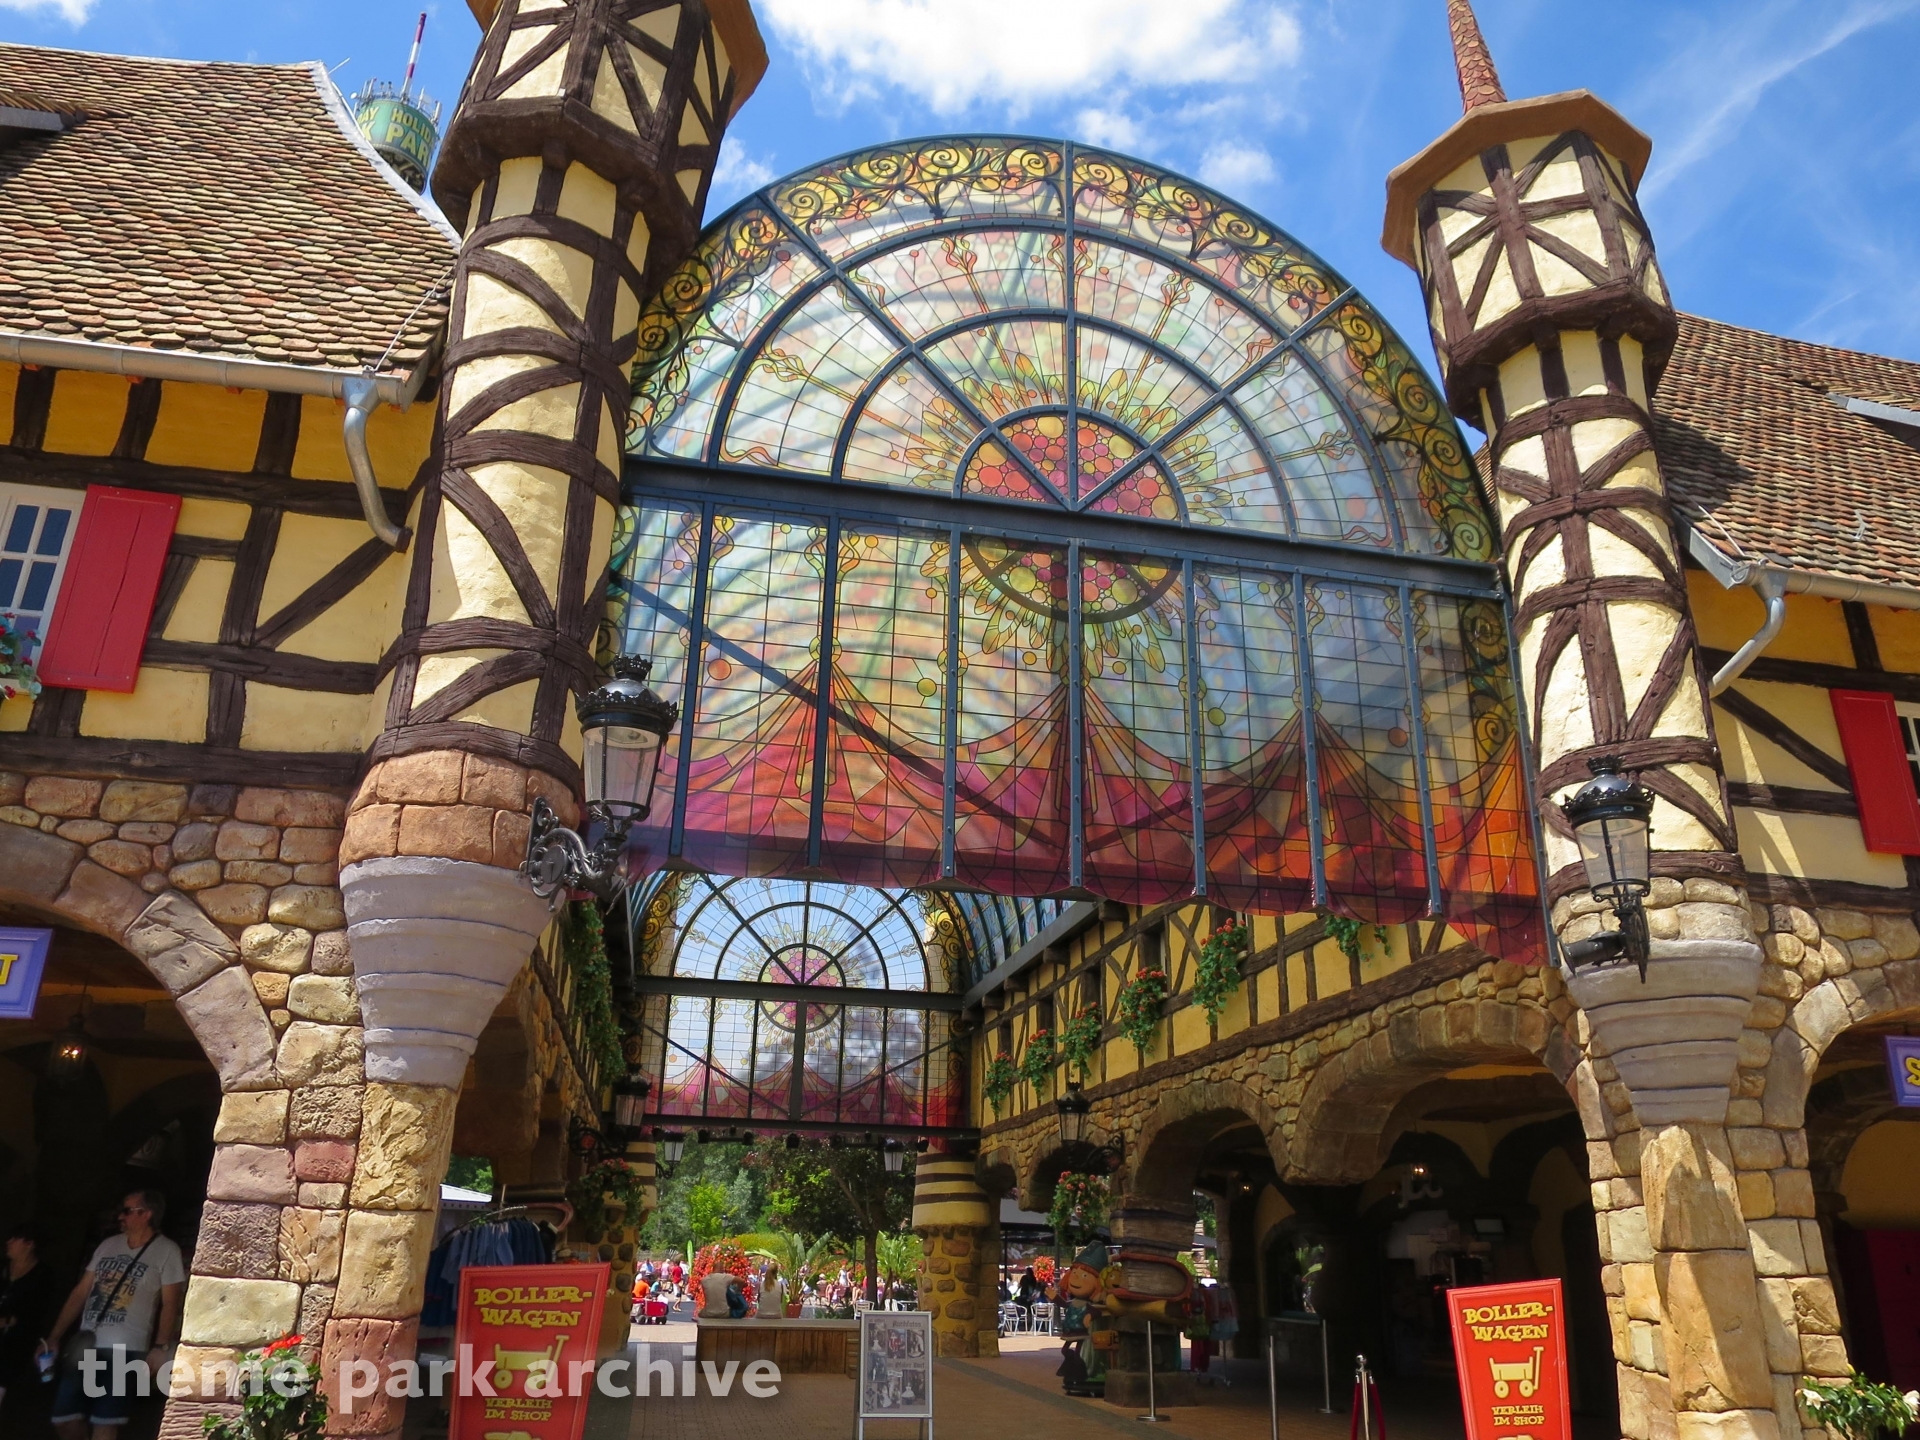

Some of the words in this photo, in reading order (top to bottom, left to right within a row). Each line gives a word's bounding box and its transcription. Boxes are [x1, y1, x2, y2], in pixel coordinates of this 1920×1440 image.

[474, 1286, 593, 1305] BOLLER-
[480, 1307, 581, 1328] WAGEN
[1463, 1302, 1553, 1324] BOLLER-
[1471, 1324, 1548, 1342] WAGEN
[485, 1397, 552, 1409] VERLEIH
[1491, 1405, 1543, 1415] VERLEIH
[484, 1409, 506, 1419] IM
[510, 1410, 552, 1421] SHOP
[1494, 1416, 1510, 1426] IM
[1513, 1416, 1545, 1425] SHOP
